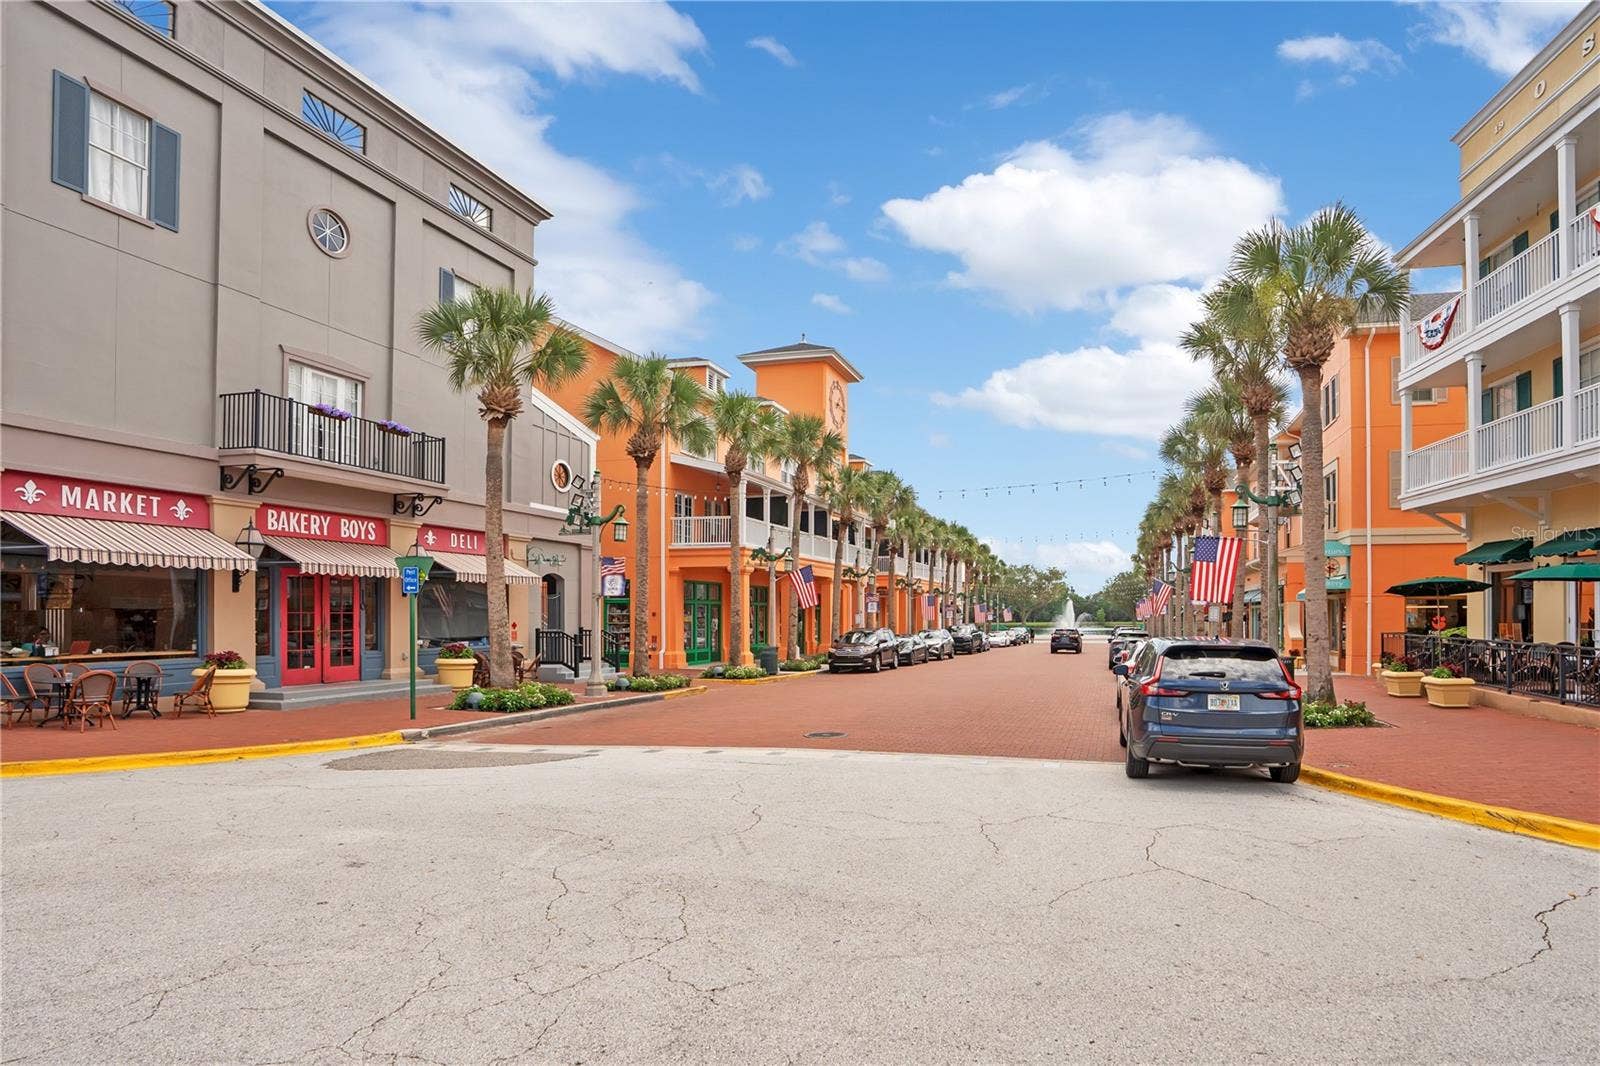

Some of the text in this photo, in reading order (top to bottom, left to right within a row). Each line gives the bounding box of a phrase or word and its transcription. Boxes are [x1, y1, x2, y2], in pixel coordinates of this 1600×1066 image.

[60, 484, 162, 518] MARKET
[266, 509, 377, 542] BAKERY BOYS
[450, 532, 478, 550] DELI
